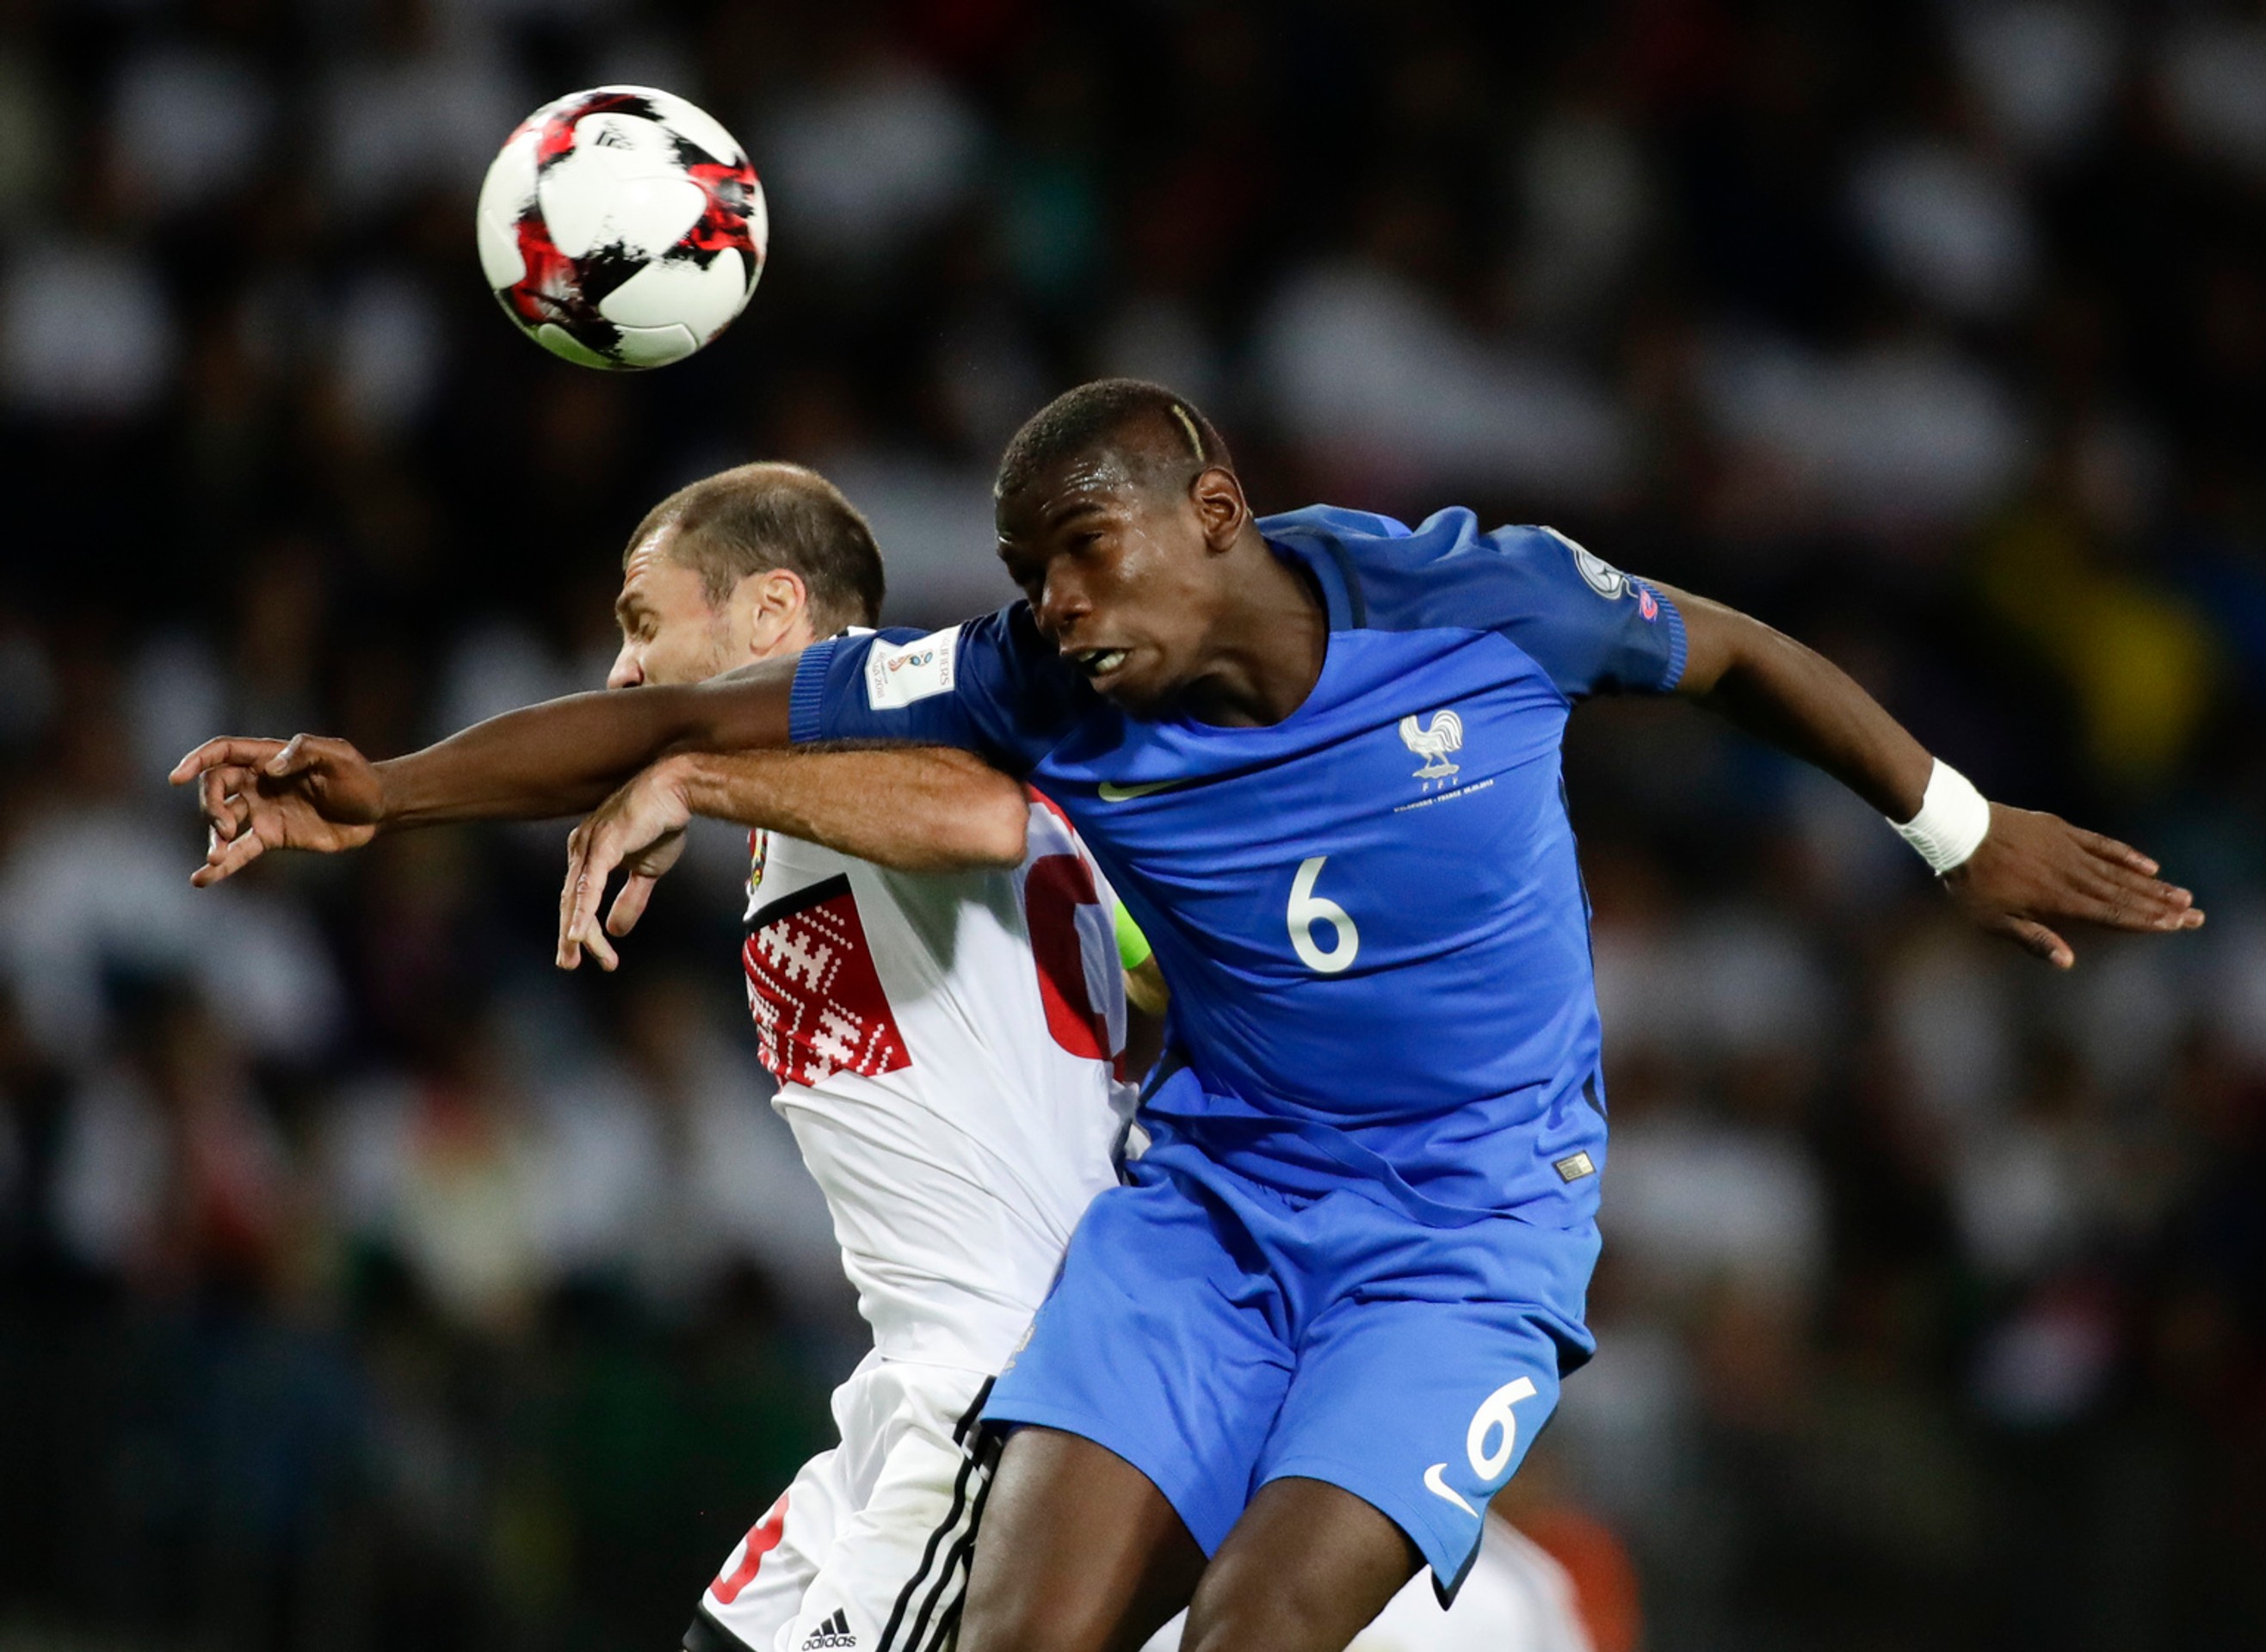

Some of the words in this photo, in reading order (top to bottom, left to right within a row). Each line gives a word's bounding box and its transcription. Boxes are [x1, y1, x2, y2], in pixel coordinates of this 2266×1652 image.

[1287, 855, 1359, 973] 6
[1466, 1376, 1537, 1481] 6
[801, 1634, 856, 1651] adidas
